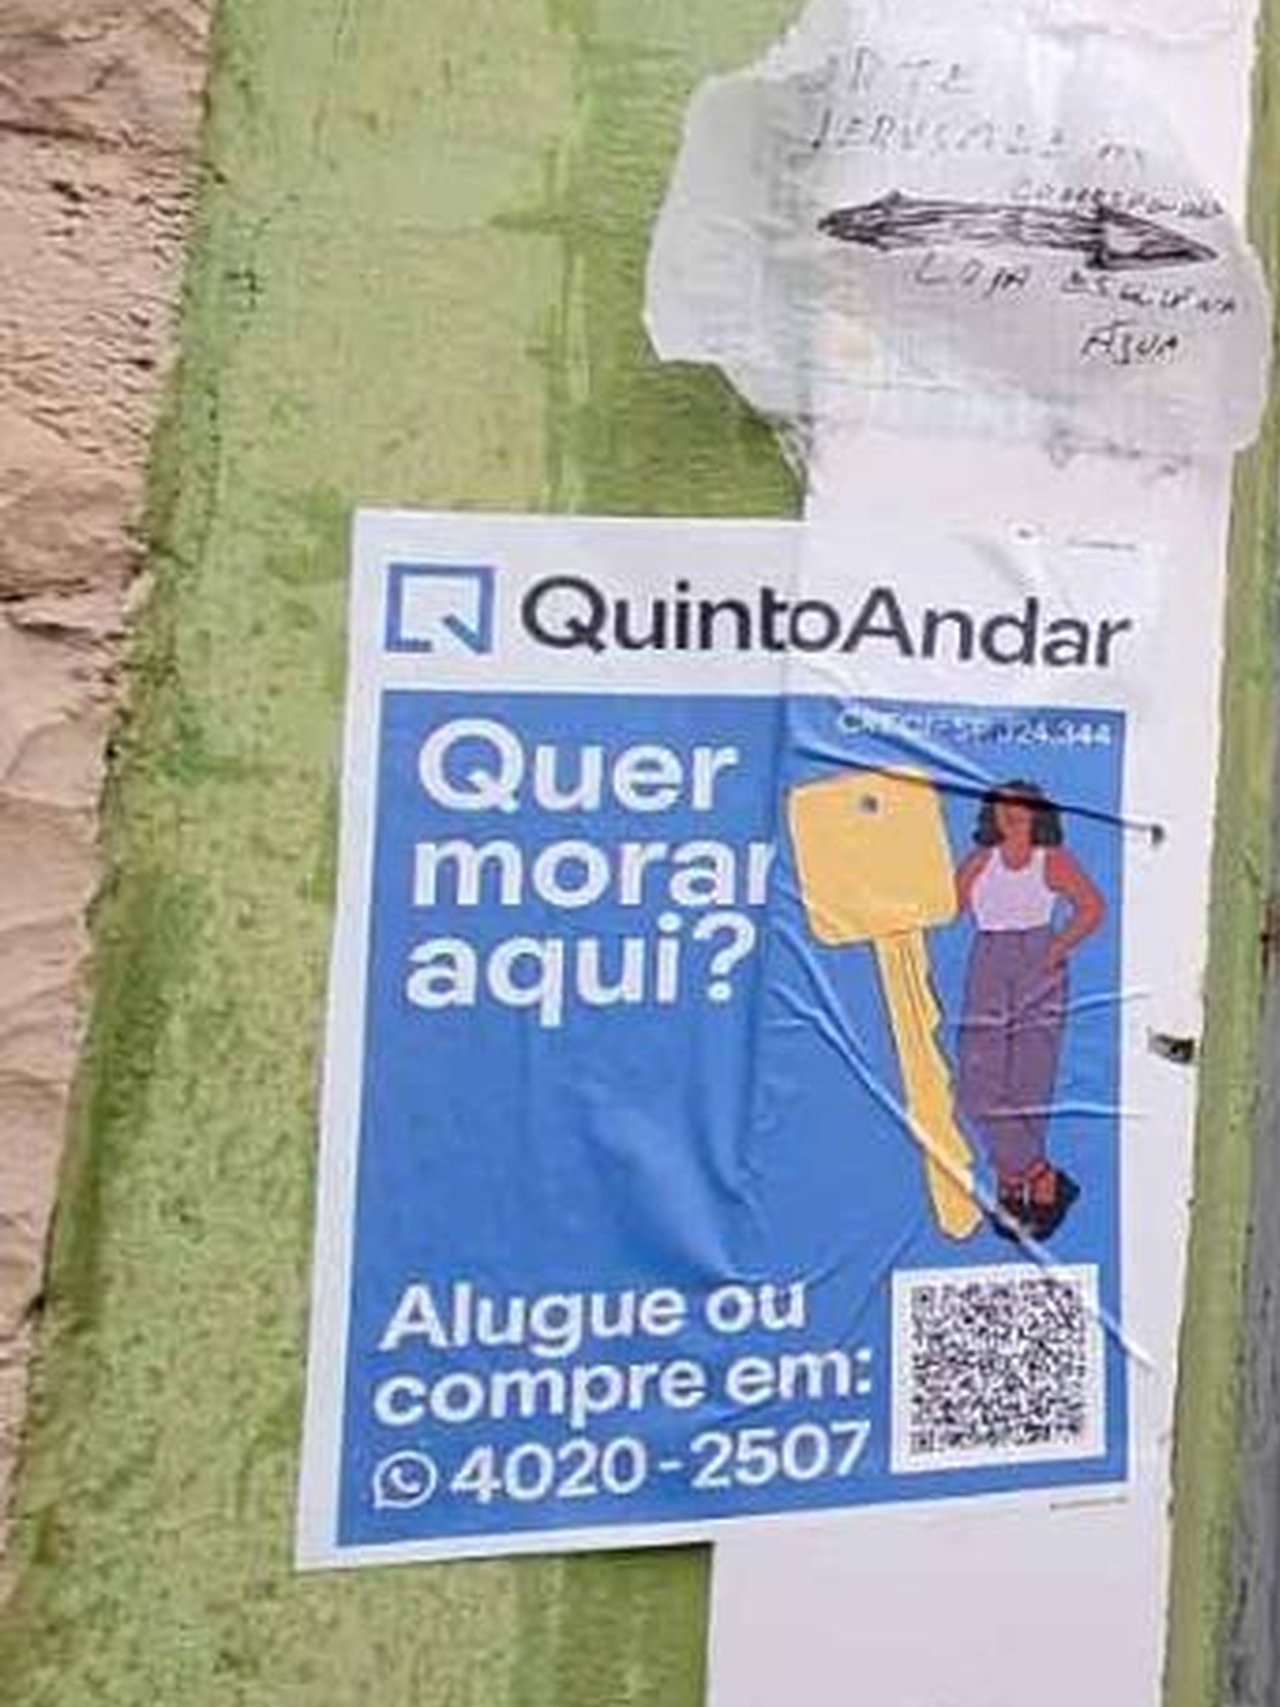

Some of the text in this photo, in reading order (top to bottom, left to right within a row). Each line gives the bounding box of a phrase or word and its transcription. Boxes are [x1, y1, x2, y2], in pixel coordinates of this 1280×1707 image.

[520, 575, 1133, 668] QuintoAndar
[418, 717, 740, 814] Quer
[413, 839, 778, 909] morar
[406, 911, 757, 1028] aqui?
[378, 1280, 807, 1358] Alugue ou
[373, 1346, 872, 1429] compre em:
